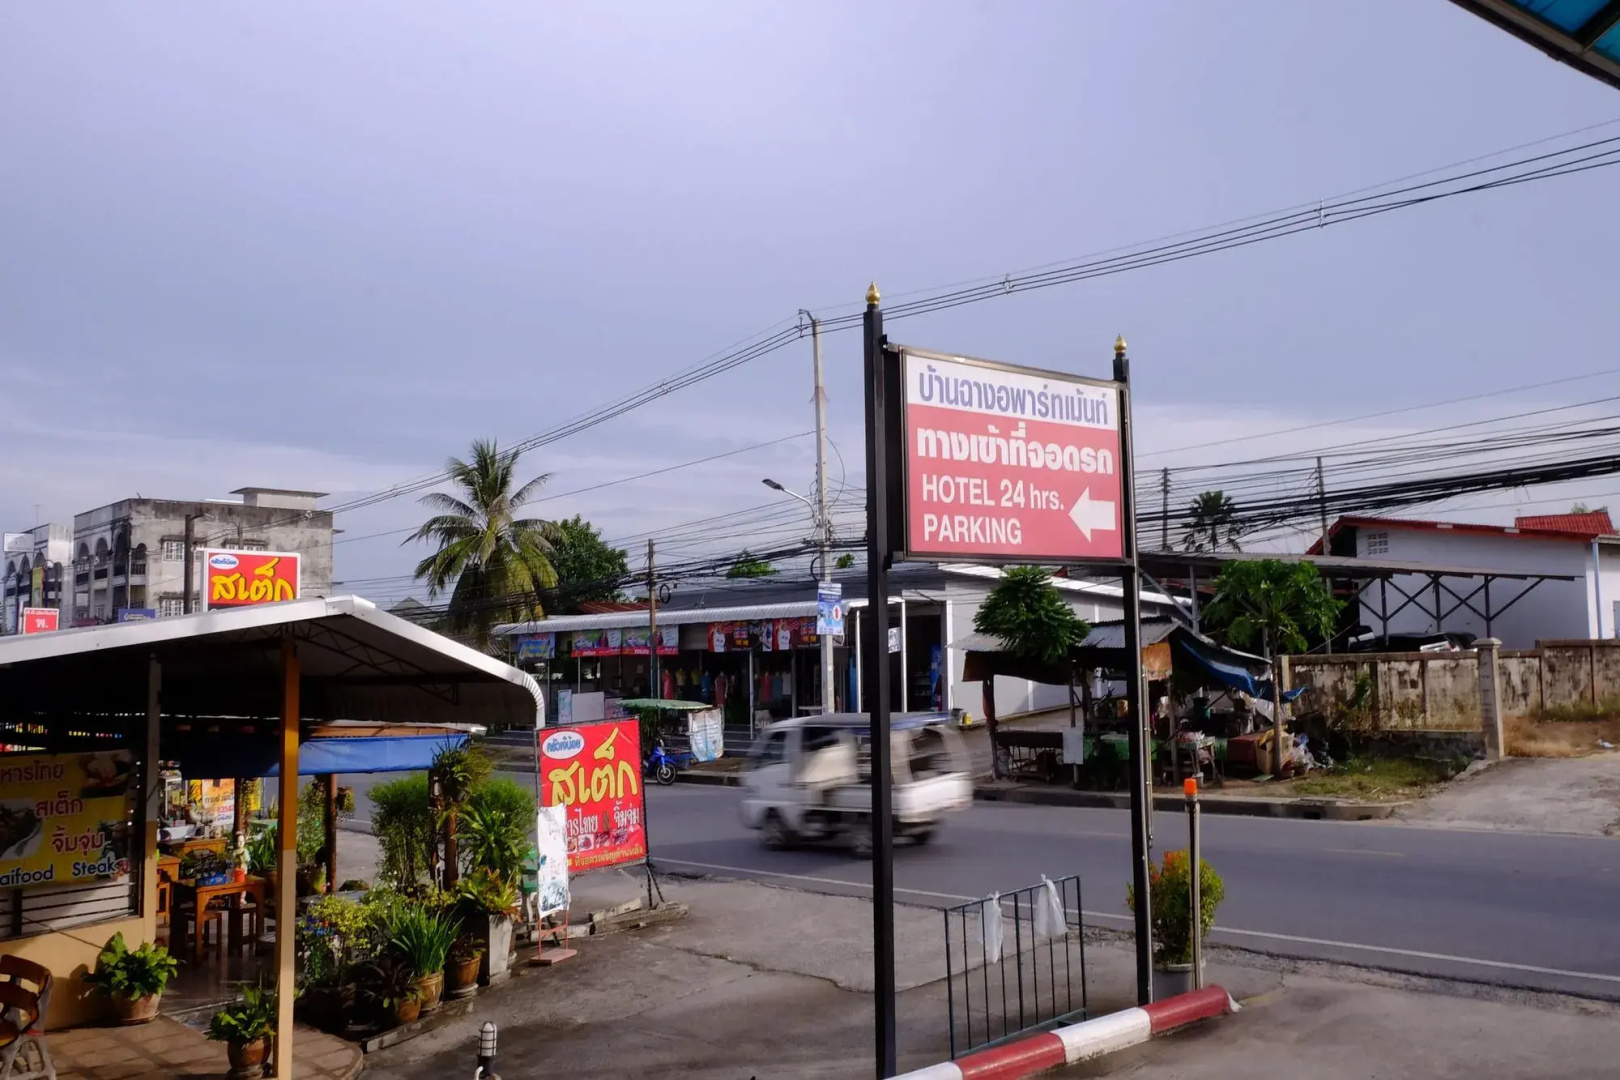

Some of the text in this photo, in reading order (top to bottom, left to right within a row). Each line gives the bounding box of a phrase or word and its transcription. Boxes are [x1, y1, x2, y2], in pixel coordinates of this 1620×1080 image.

[919, 364, 1108, 425] บ้านฉางอพาร์ทเม้นท์
[917, 421, 1114, 475] ทางเข้าที่จอดรถ
[922, 473, 1065, 511] HOTEL 24 hrs.
[923, 513, 1022, 545] PARKING
[0, 760, 64, 782] หารไทย
[35, 790, 83, 818] สเต็ก
[566, 807, 598, 837] ารไทย
[52, 825, 105, 856] จิ้มจุ่ม
[0, 857, 116, 886] aifood Steak
